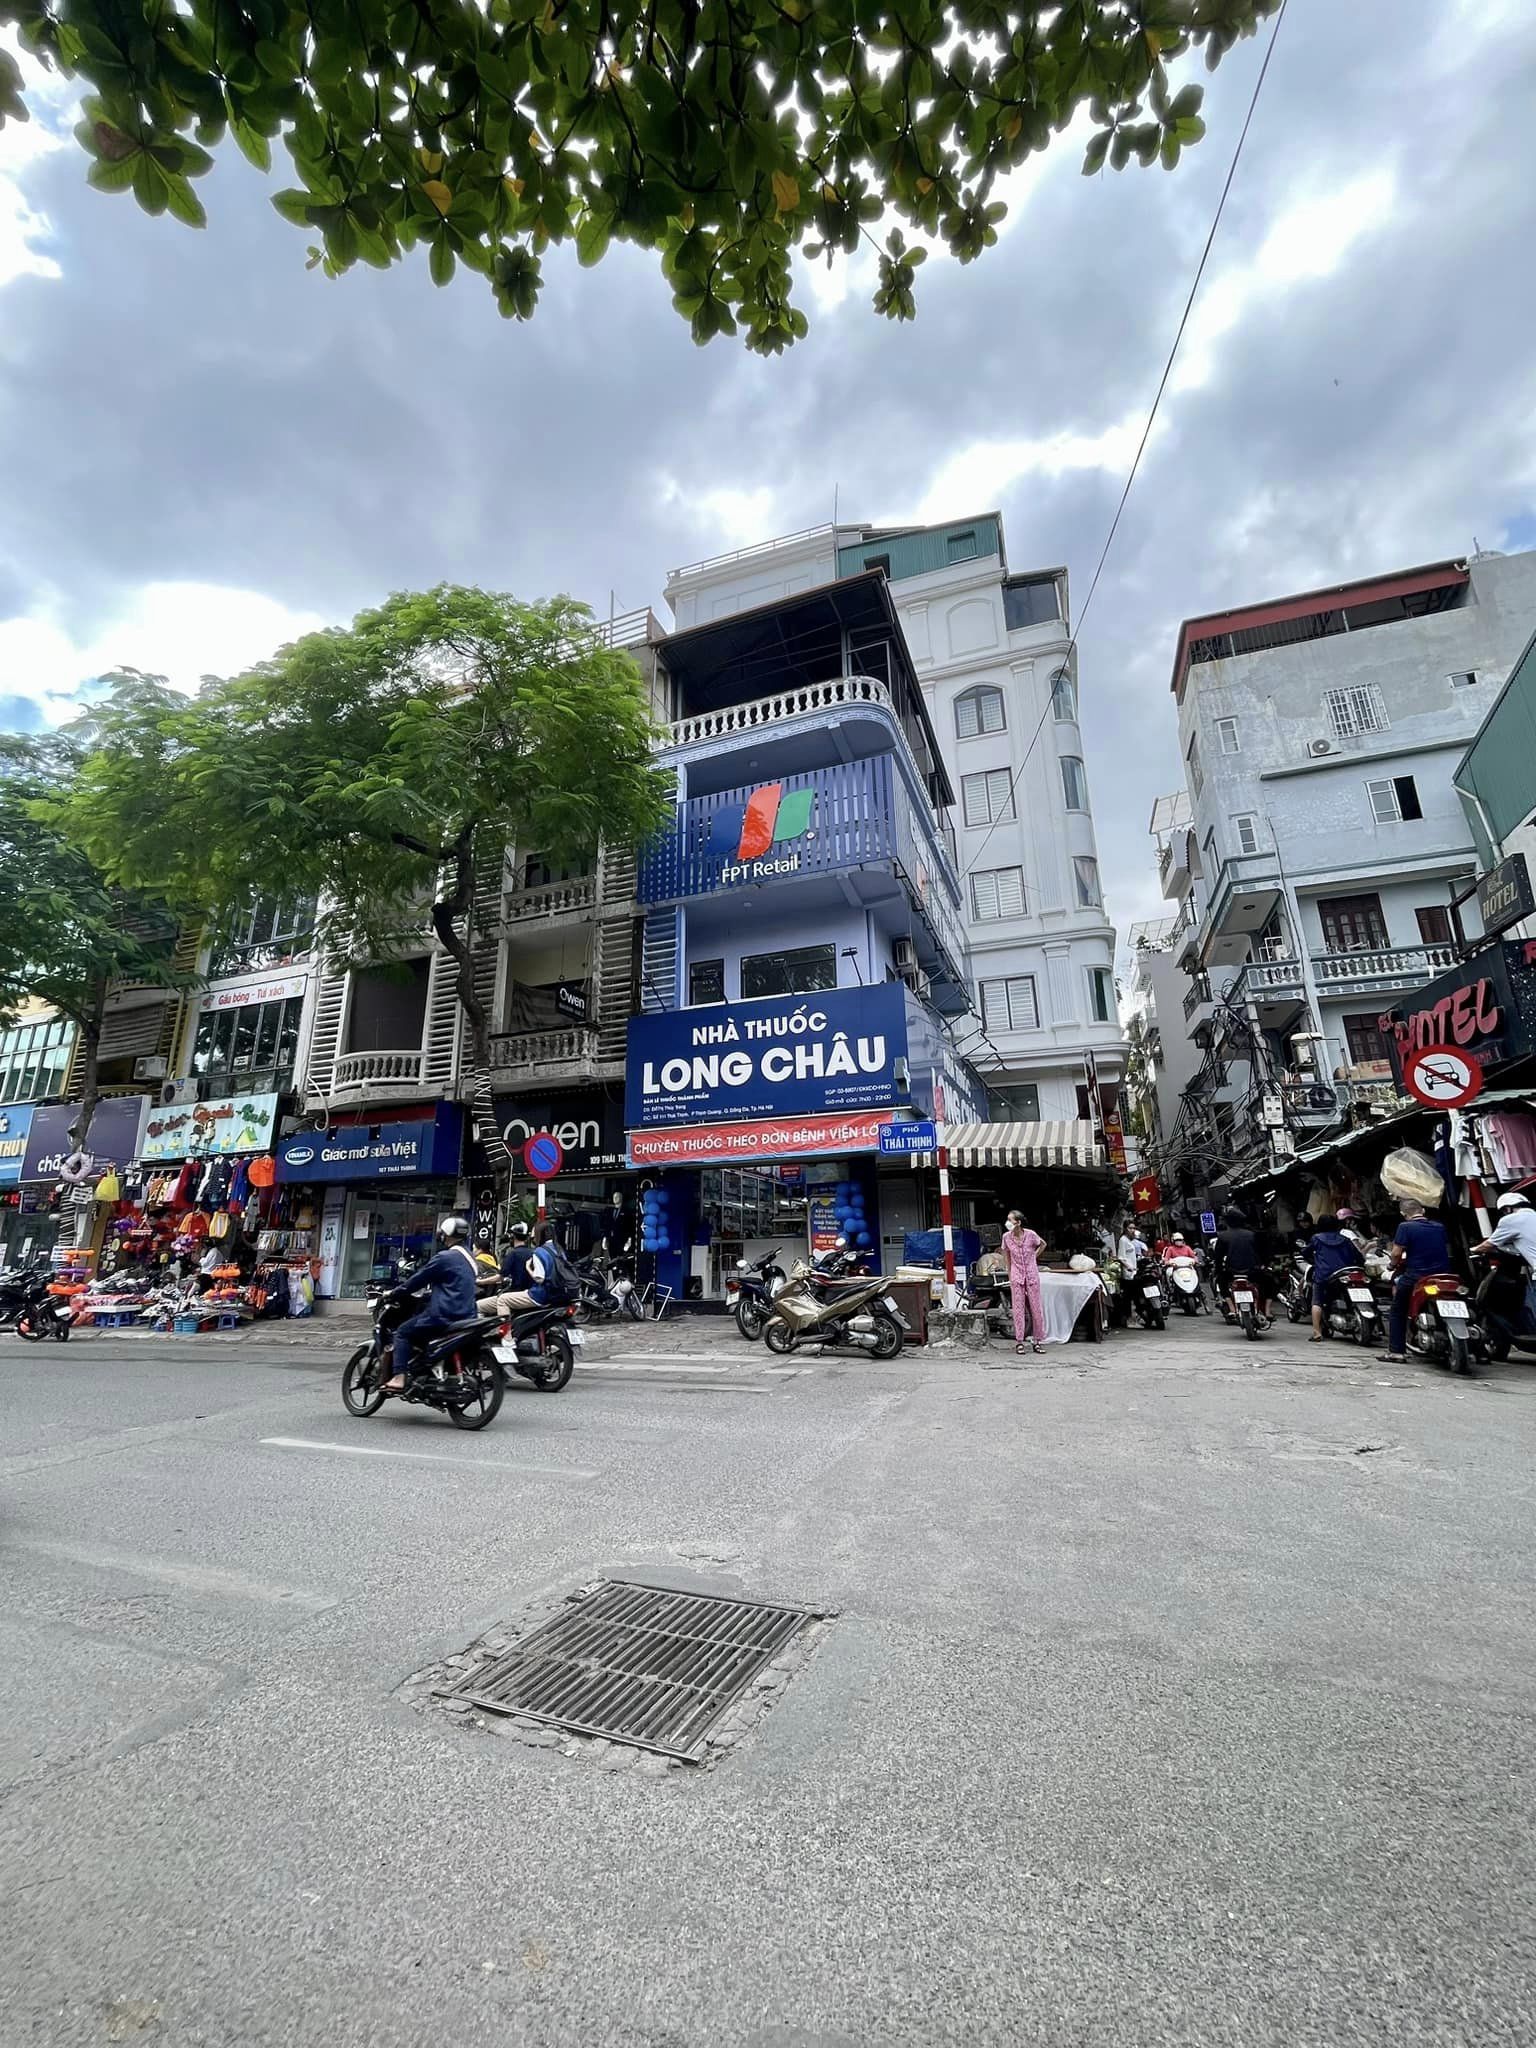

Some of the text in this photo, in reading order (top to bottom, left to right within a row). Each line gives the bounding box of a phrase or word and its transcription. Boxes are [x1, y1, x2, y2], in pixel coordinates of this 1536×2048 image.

[722, 854, 799, 884] FPT Retail
[1482, 881, 1518, 921] HOTEL
[559, 987, 585, 1009] Owen
[692, 1004, 828, 1046] NHÀ THUỐC
[1394, 977, 1499, 1070] HOTEL
[642, 1032, 886, 1095] LONG CHÂU
[634, 1138, 679, 1155] CHUYÊN
[682, 1133, 723, 1151] THUỐC
[726, 1135, 758, 1148] THEO
[761, 1131, 790, 1144] ĐƠN
[793, 1129, 825, 1145] BỆNH
[829, 1126, 858, 1142] VIỆN
[884, 1135, 933, 1150] THÁI THỊNH
[902, 1125, 920, 1134] PHỐ
[321, 1145, 348, 1162] Giấc
[348, 1145, 369, 1160] mơ
[391, 1141, 417, 1159] Việt
[601, 1153, 616, 1164] THÁI
